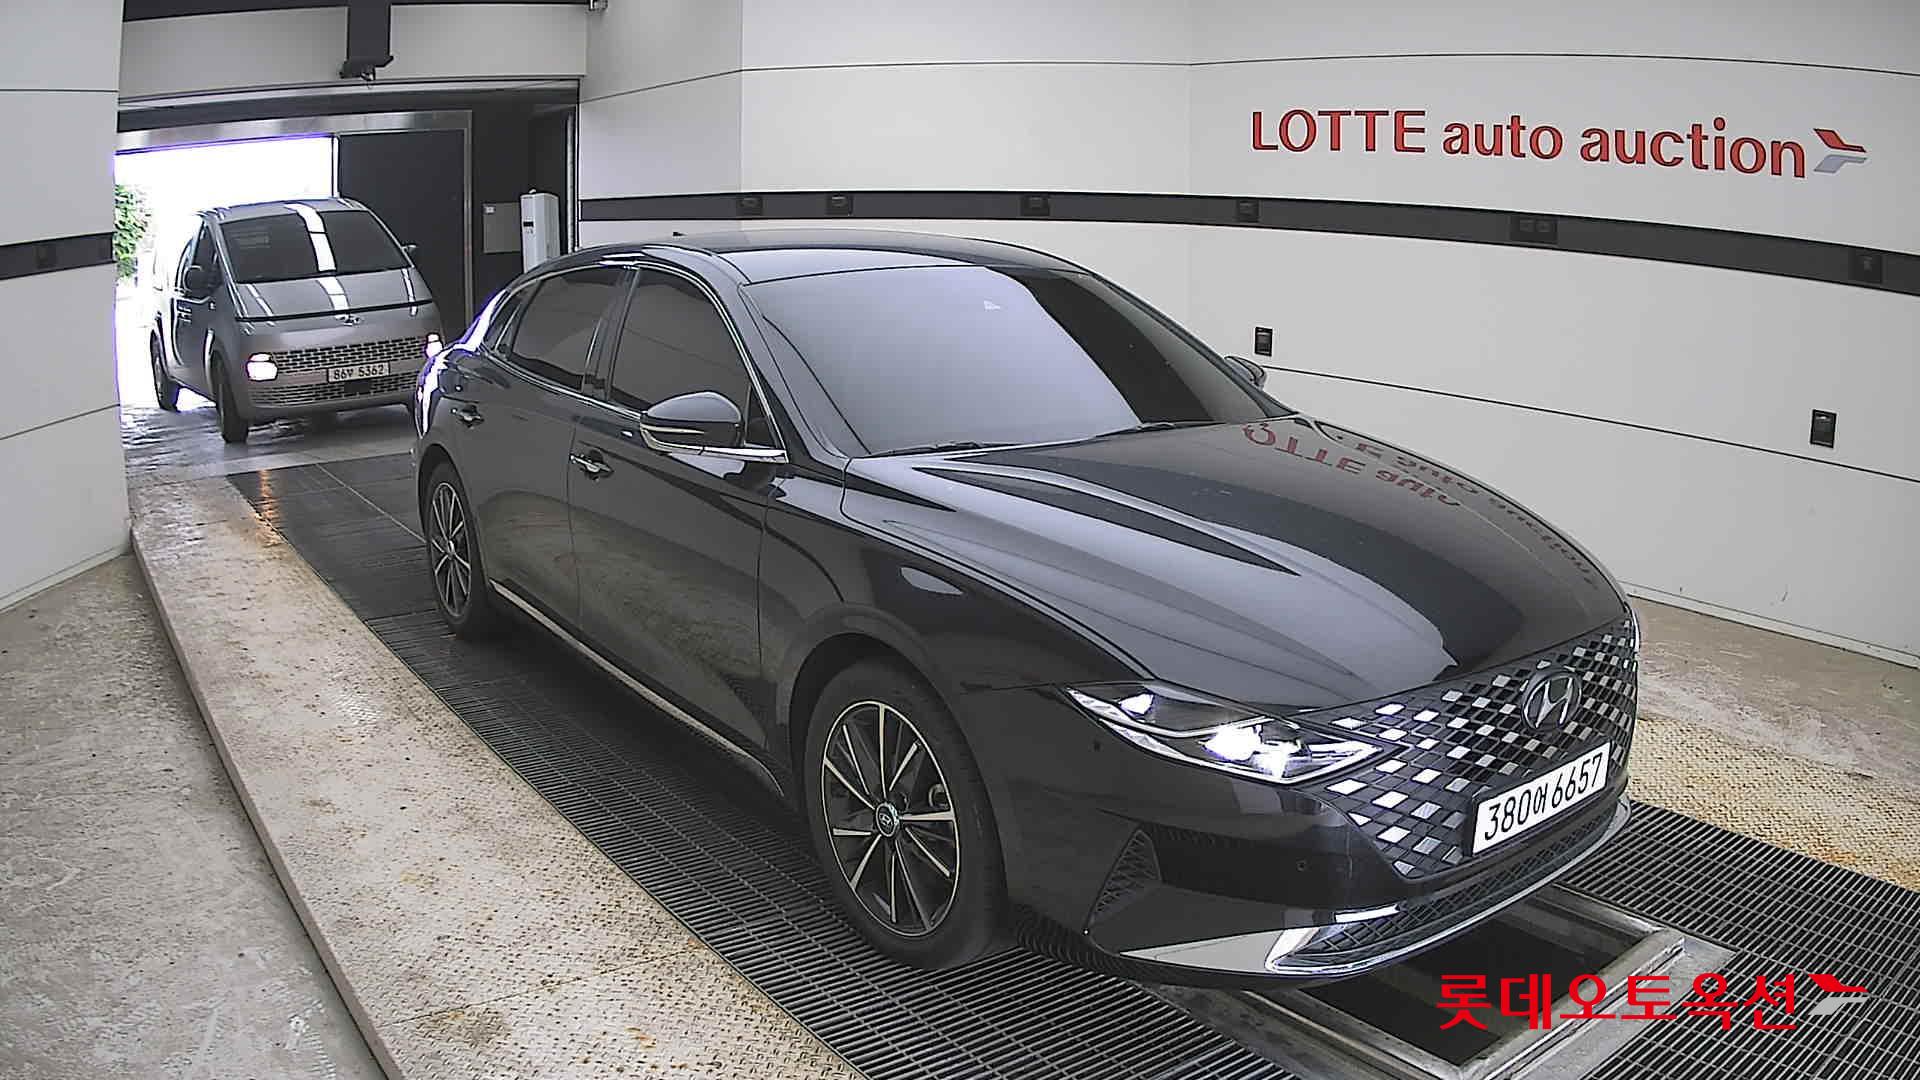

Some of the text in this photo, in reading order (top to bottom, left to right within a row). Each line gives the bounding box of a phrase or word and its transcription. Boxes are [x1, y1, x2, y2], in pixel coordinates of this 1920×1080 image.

[1252, 109, 1806, 178] LOTTE auto auction
[358, 364, 384, 377] 5362
[1484, 752, 1603, 841] 380어 6657
